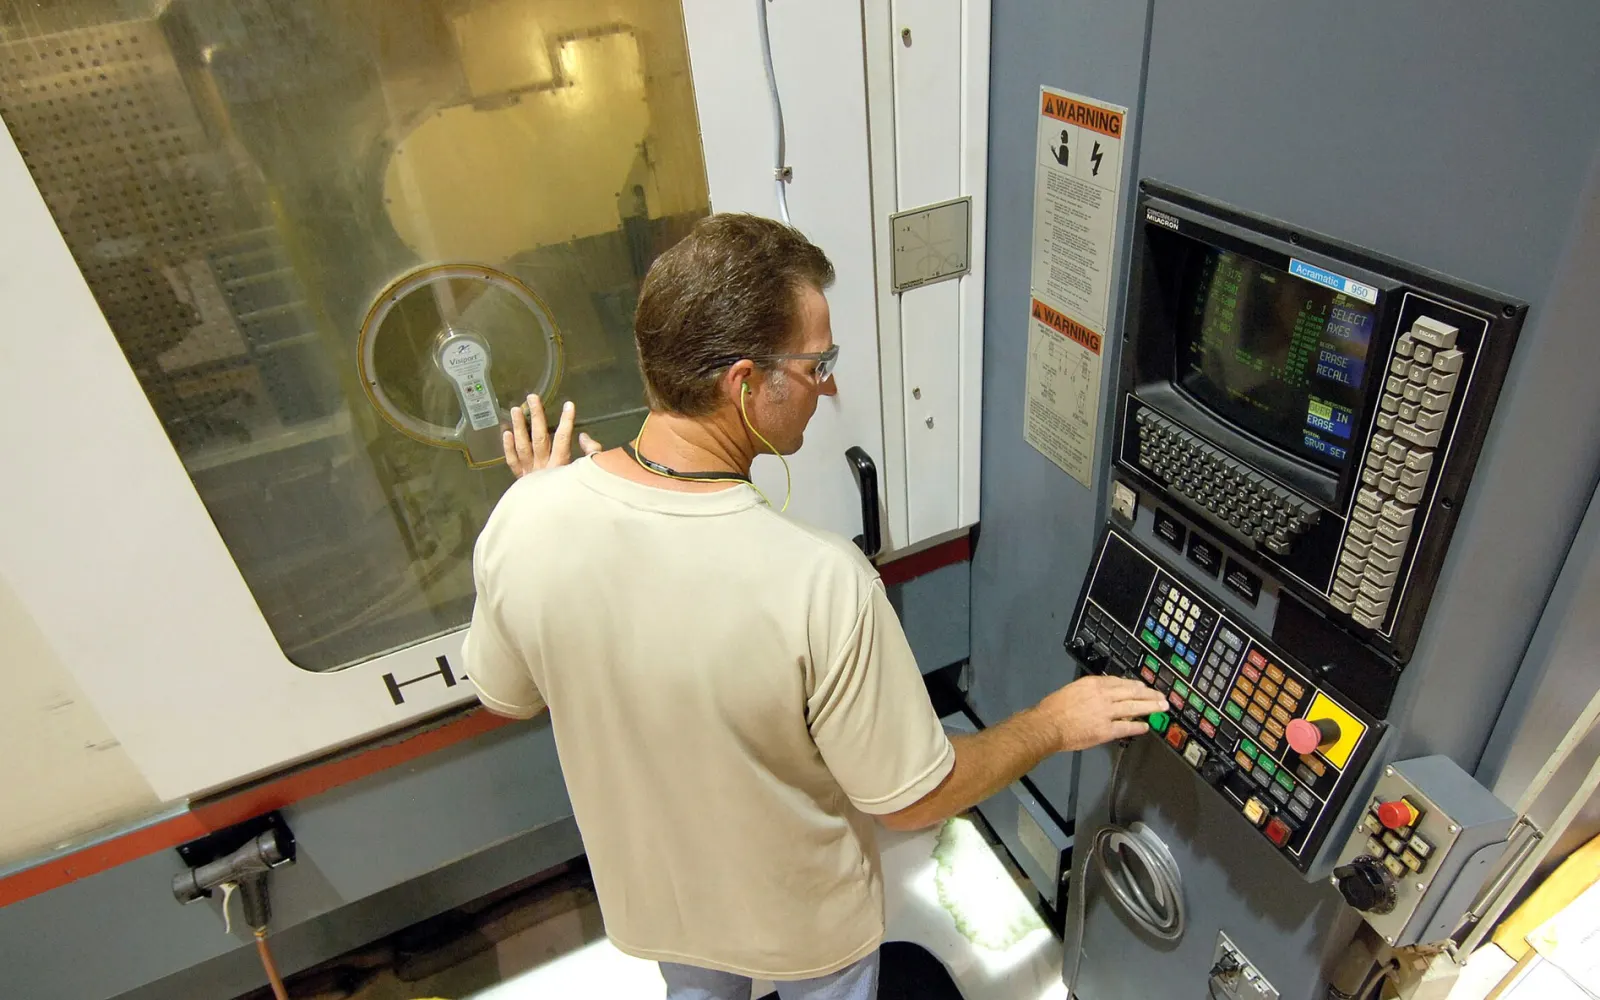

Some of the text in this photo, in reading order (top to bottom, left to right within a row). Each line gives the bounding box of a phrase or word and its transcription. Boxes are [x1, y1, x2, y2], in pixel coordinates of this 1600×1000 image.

[1056, 98, 1120, 134] WARNING
[1146, 213, 1179, 230] MILACRON
[1296, 264, 1339, 287] Acramatic
[1351, 284, 1368, 298] 950
[1331, 307, 1367, 327] SELECT
[1044, 306, 1099, 350] WARNING
[1326, 322, 1351, 338] AXES
[449, 354, 477, 366] Visiport
[1319, 350, 1349, 368] ERASE
[1316, 363, 1350, 384] RECALL
[1307, 414, 1334, 432] ERASE
[1336, 412, 1348, 424] IN
[1304, 436, 1346, 459] SRVO SET
[382, 654, 469, 706] H
